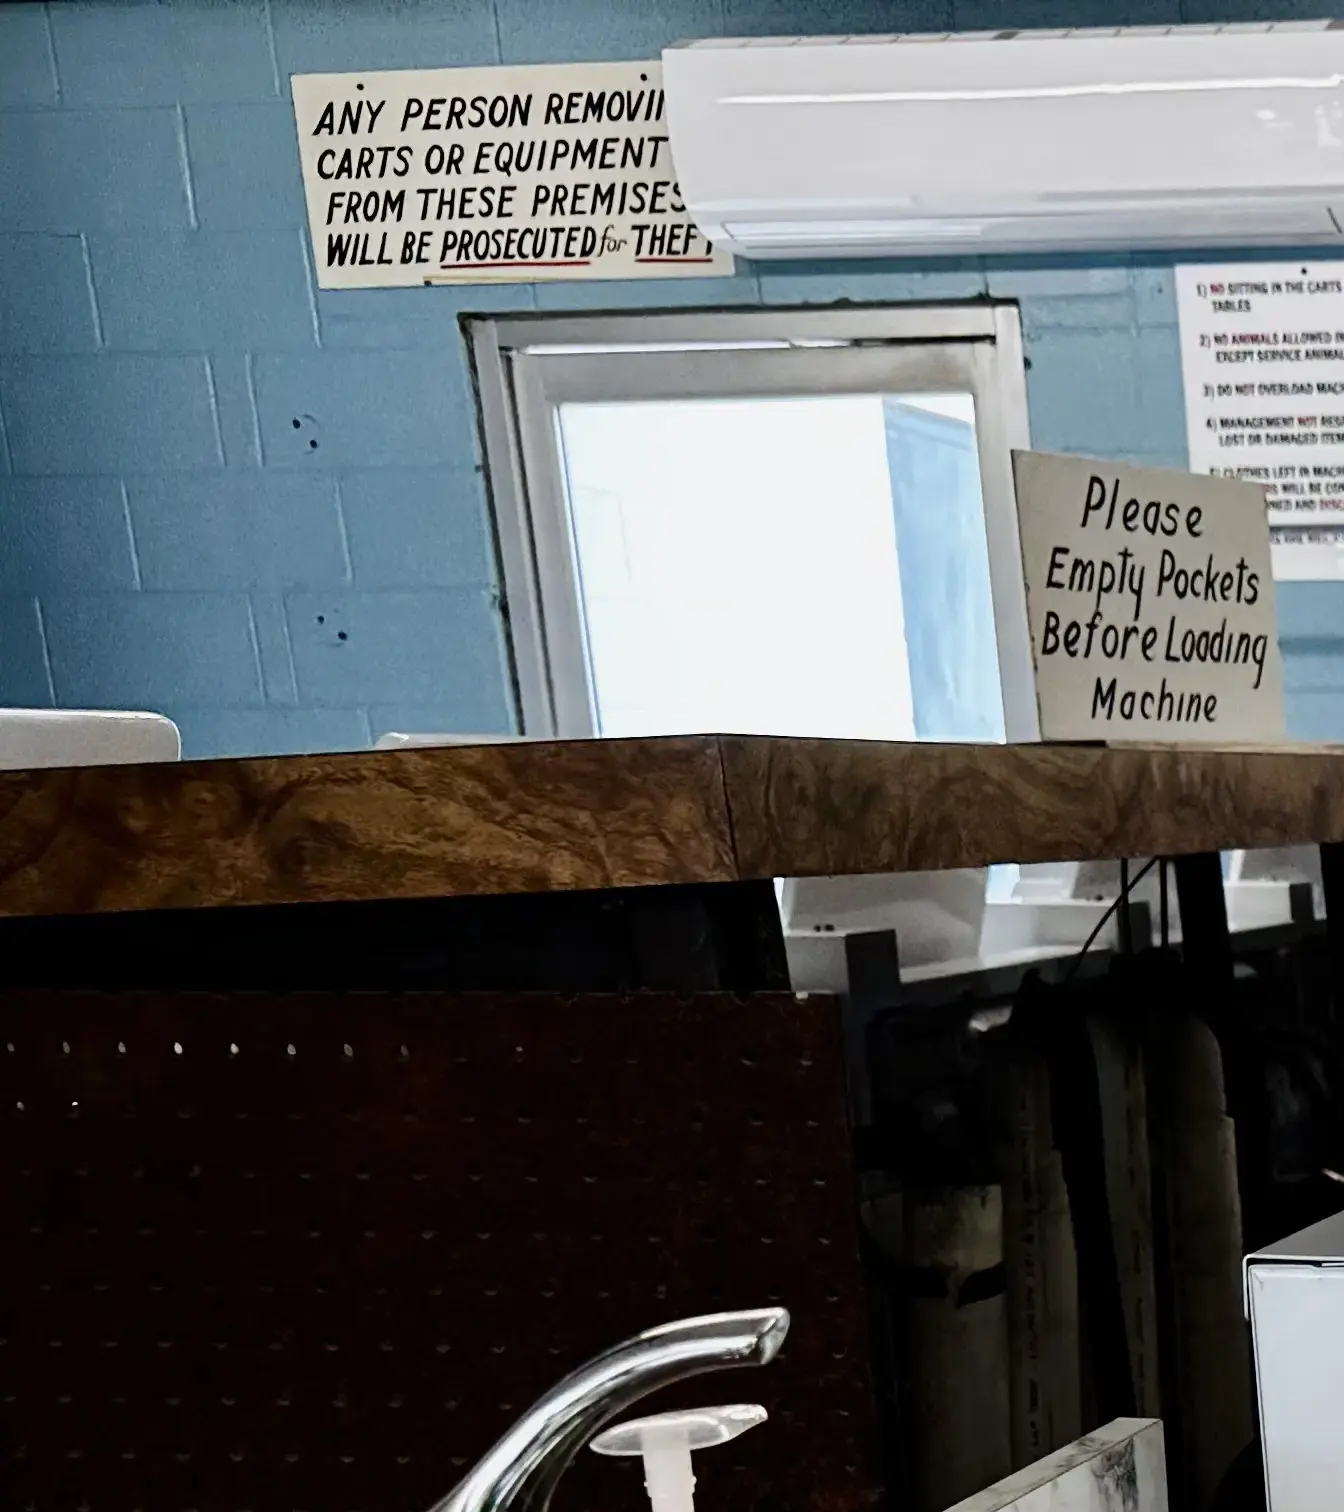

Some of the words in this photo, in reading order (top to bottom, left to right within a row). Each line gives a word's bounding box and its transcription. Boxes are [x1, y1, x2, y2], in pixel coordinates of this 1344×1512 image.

[313, 99, 386, 136] ANY
[400, 93, 532, 133] PERSON
[544, 88, 665, 125] REMOVI
[316, 144, 414, 180] CARTS
[424, 143, 465, 177] OR
[473, 135, 669, 177] EQUIPMENT
[326, 188, 406, 226] FROM
[416, 185, 518, 222] THESE
[531, 180, 687, 217] PREMISES
[326, 229, 393, 268] WILL
[400, 230, 433, 264] BE
[440, 227, 597, 262] PROSECUTED
[597, 224, 628, 258] for
[1285, 281, 1303, 294] THE
[1308, 280, 1342, 294] CARTS
[1231, 332, 1278, 345] ANIMALS
[1282, 331, 1332, 344] ALLOWED
[1216, 350, 1254, 363] EXCEPT
[1257, 349, 1301, 362] SERVICE
[1217, 383, 1233, 397] DO
[1235, 383, 1255, 396] NOT
[1258, 382, 1314, 396] OVERLOAD
[1220, 416, 1294, 429] MANAGEMENT
[1296, 415, 1317, 428] NOT
[1219, 433, 1245, 447] LOST
[1248, 433, 1262, 446] OR
[1265, 432, 1318, 445] DAMAGED
[1272, 466, 1296, 478] LEFT
[1282, 483, 1305, 495] WILL
[1080, 475, 1204, 538] Please
[1295, 499, 1316, 512] AND
[1046, 546, 1145, 622] Empty
[1156, 549, 1259, 606] Pockets
[1041, 610, 1158, 661] Before
[1165, 615, 1268, 690] Loading
[1091, 676, 1218, 723] Machine
